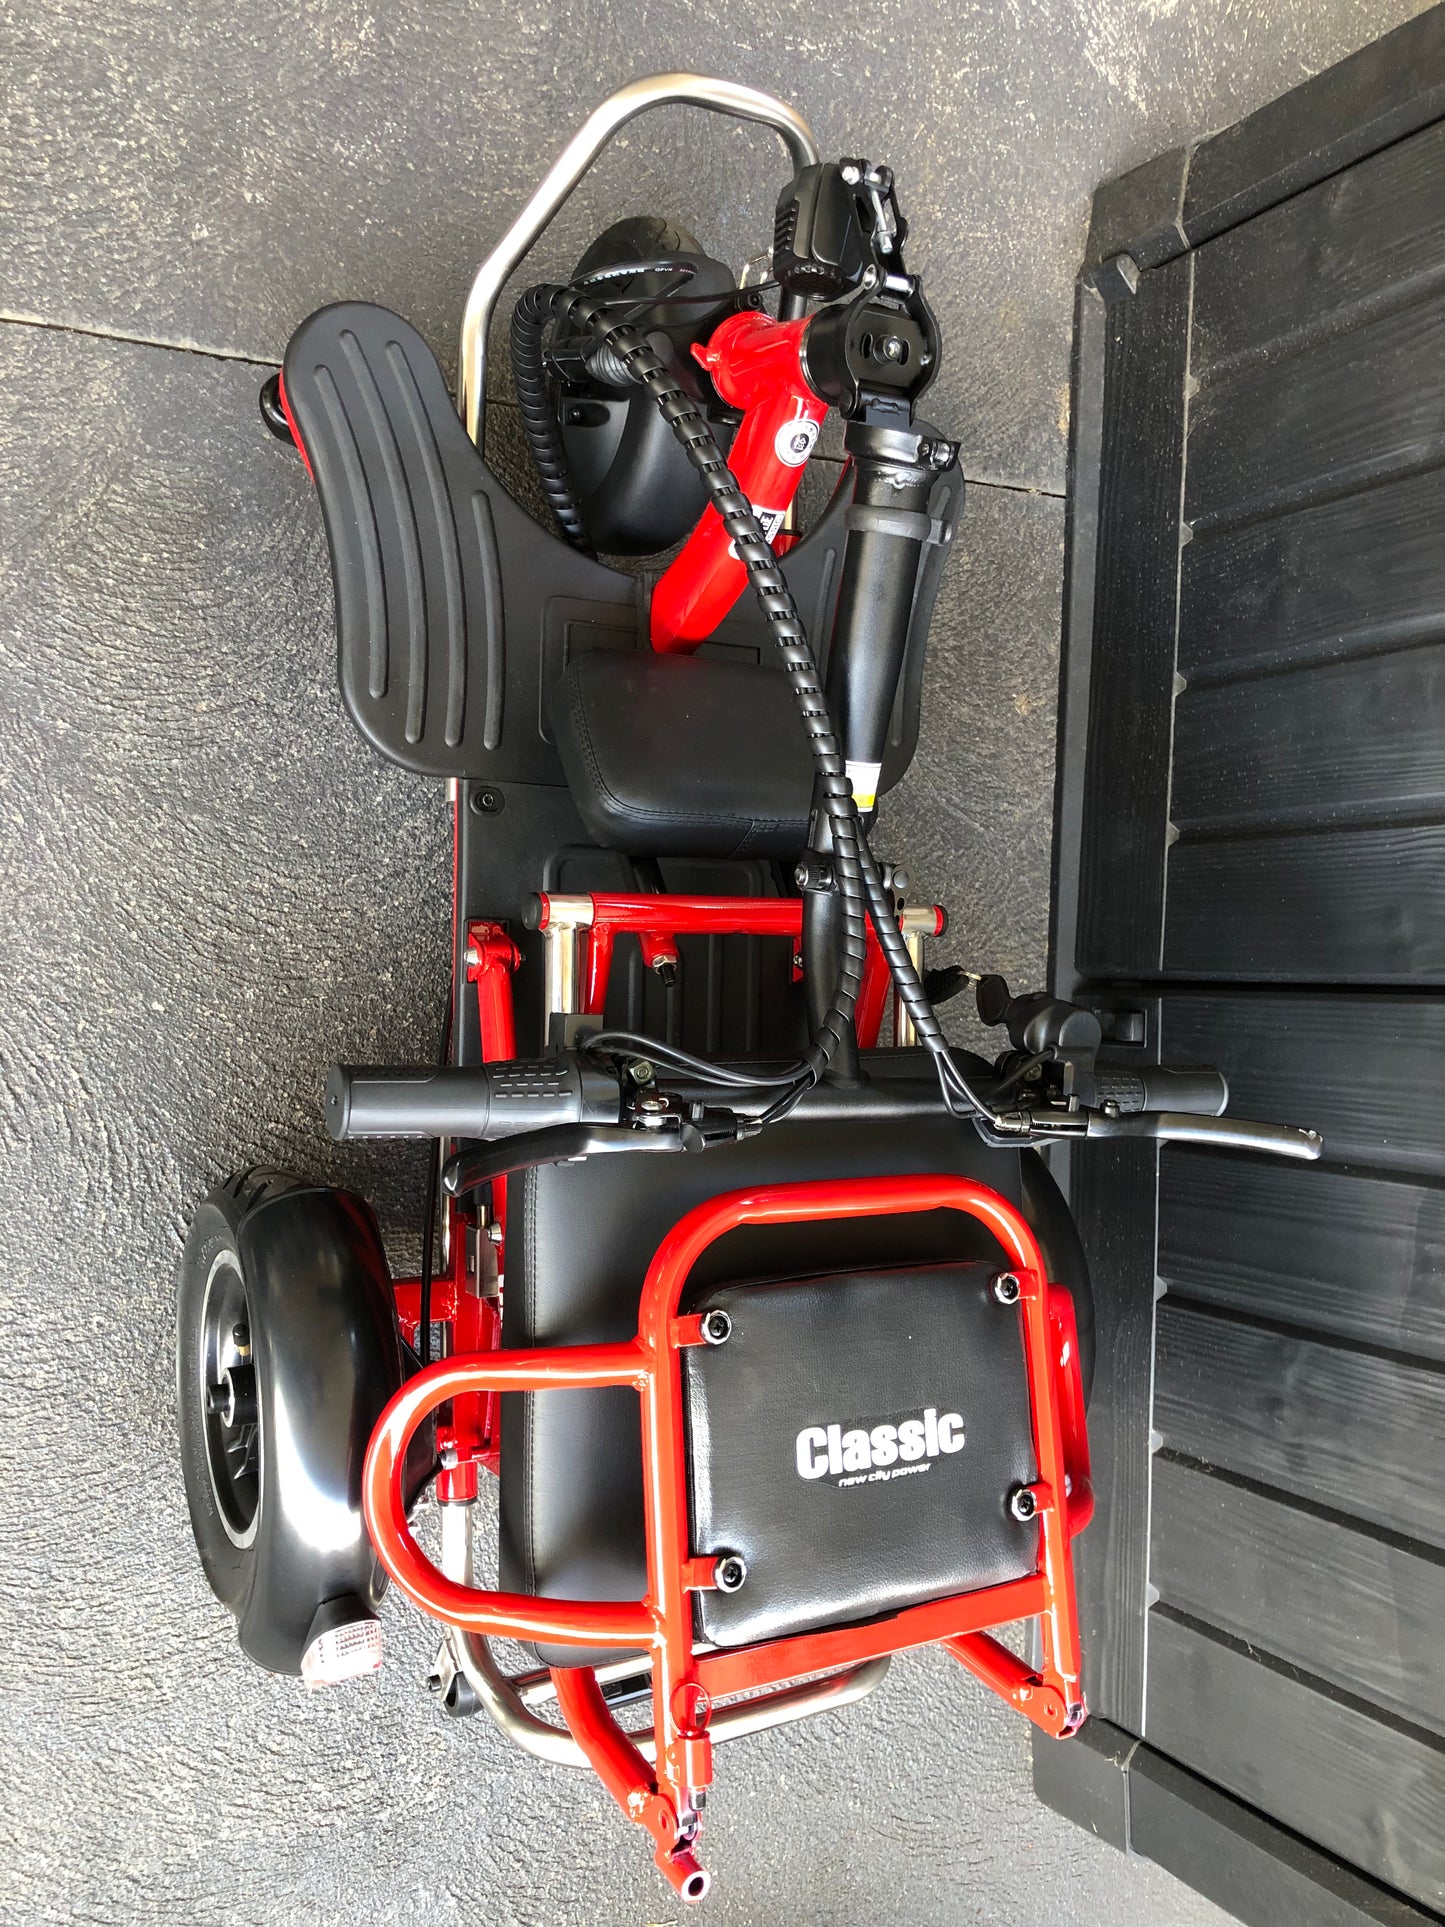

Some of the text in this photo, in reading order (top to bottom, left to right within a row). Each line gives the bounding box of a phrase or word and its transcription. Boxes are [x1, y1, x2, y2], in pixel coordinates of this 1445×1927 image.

[796, 1408, 966, 1480] Classic
[838, 1463, 931, 1487] new city power
